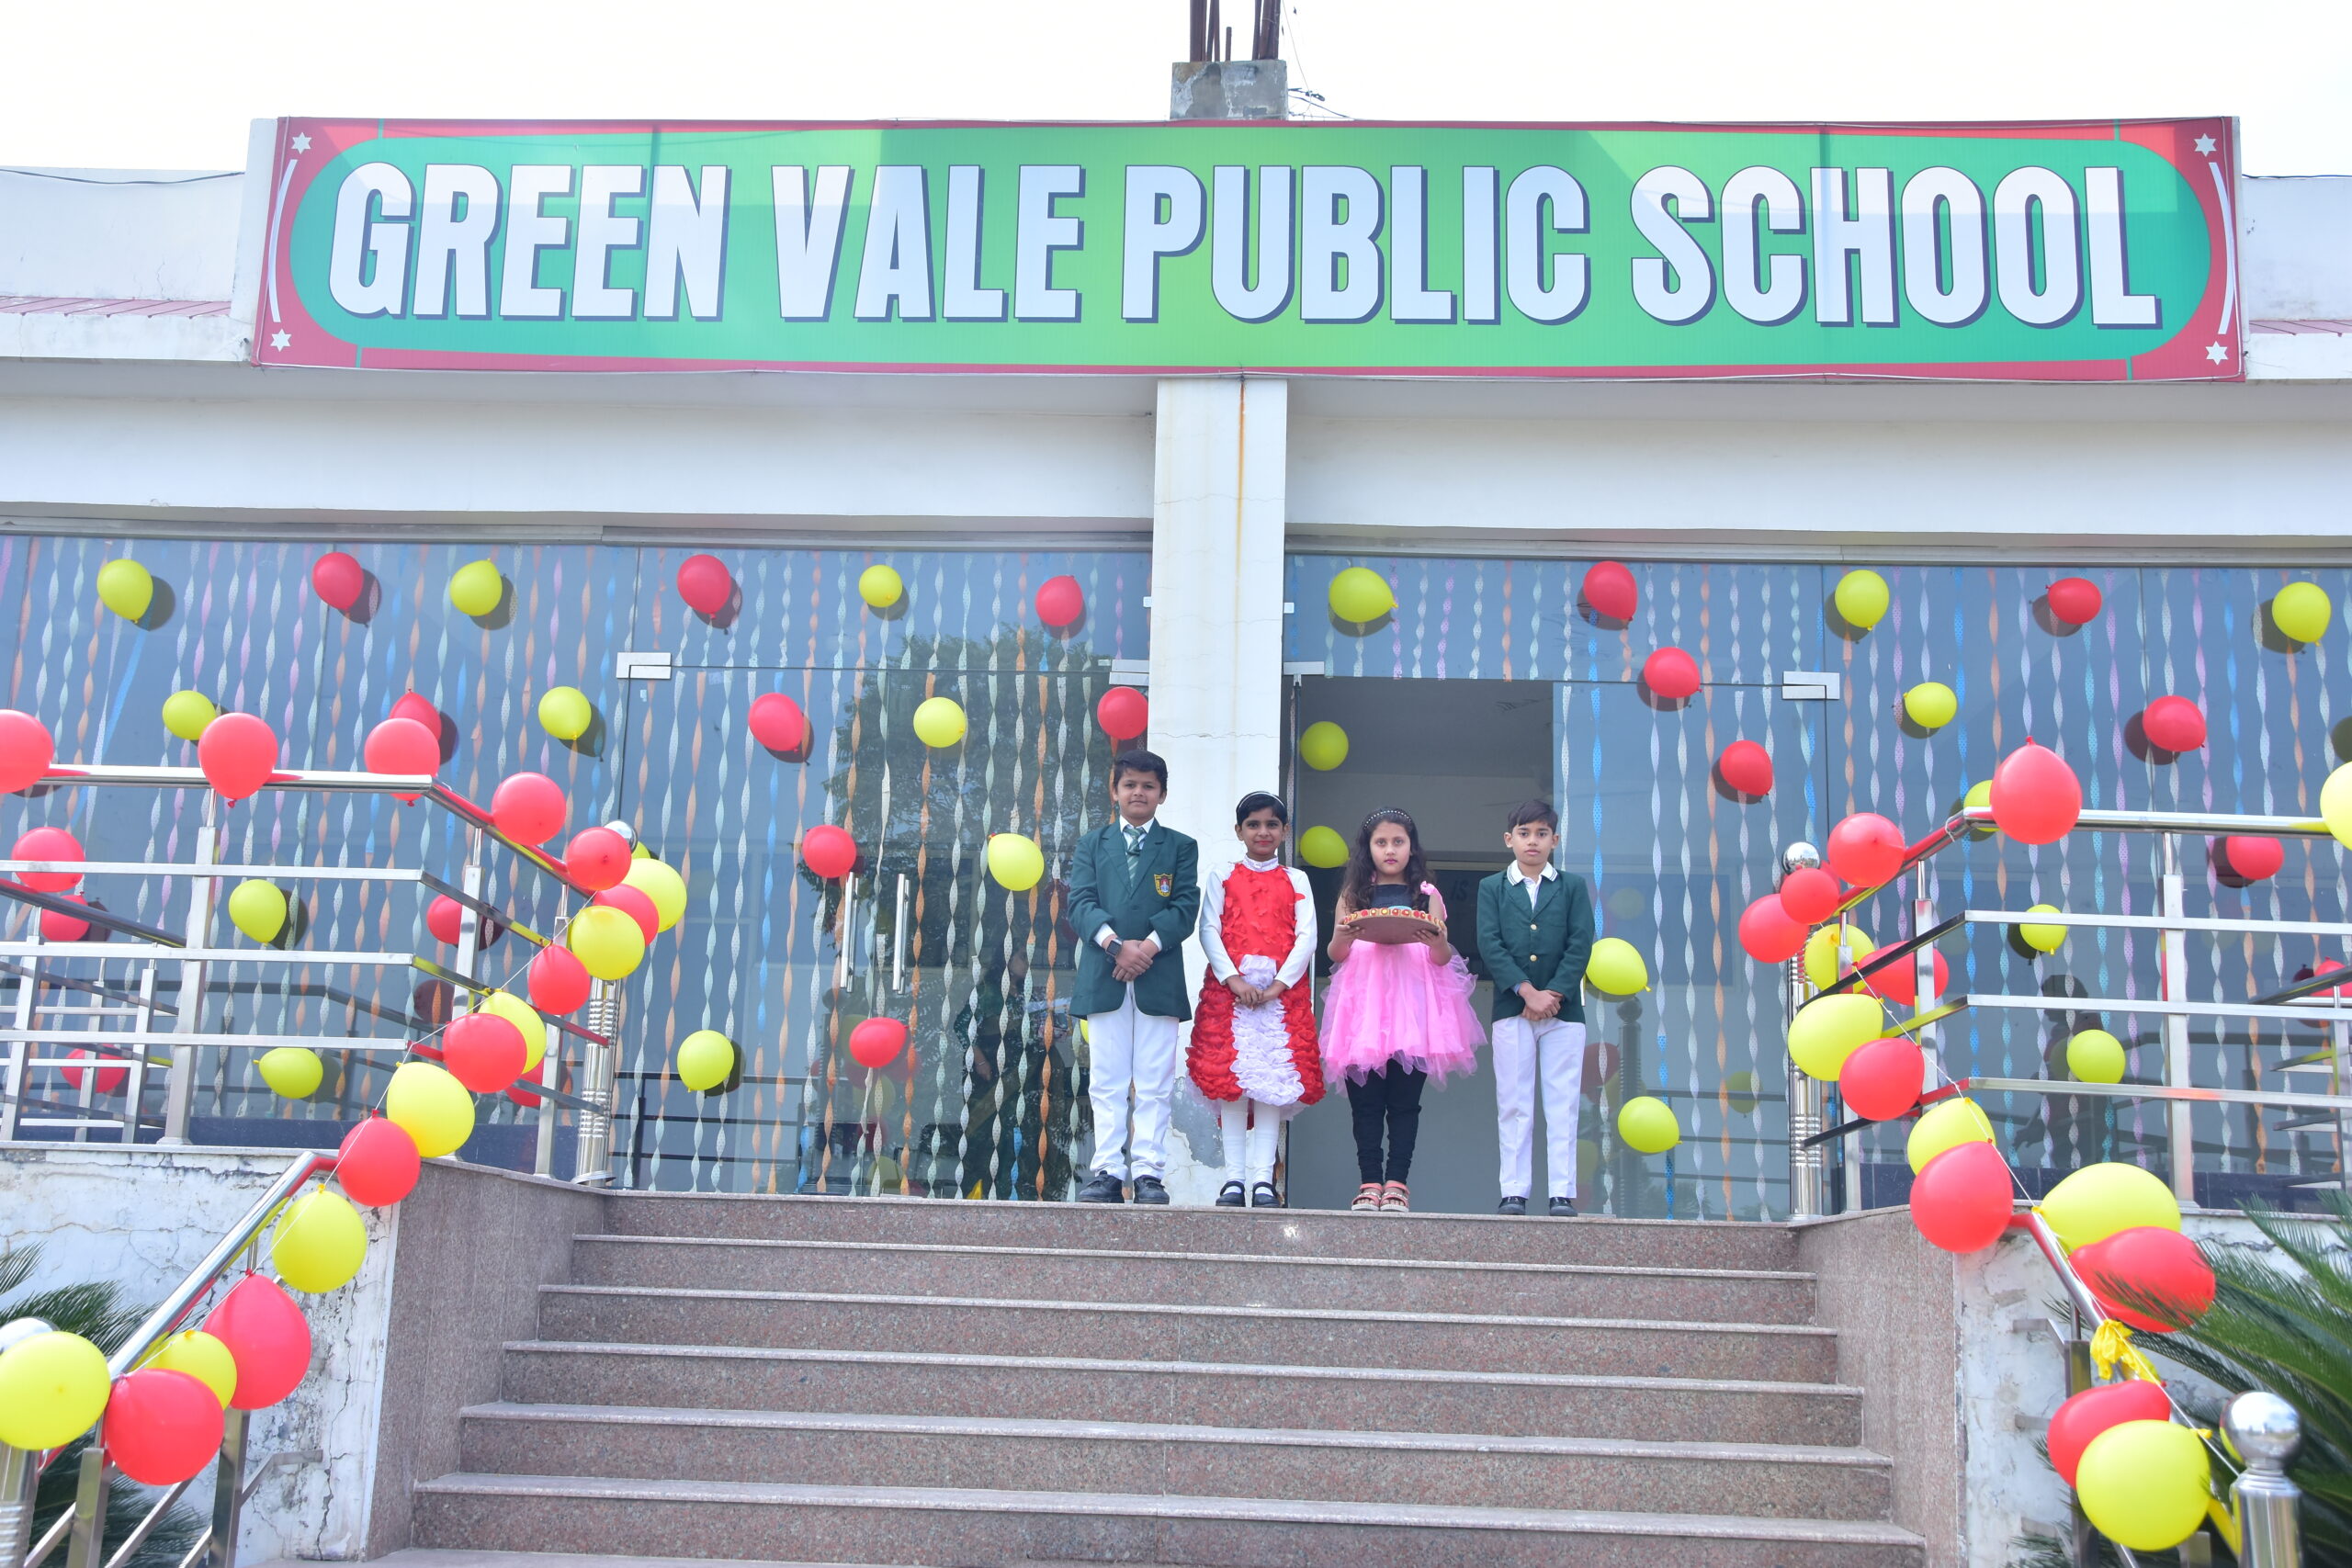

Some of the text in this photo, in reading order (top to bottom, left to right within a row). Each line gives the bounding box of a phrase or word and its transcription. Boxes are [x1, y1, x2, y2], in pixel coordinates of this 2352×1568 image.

[329, 162, 2163, 329] GREEN VALE PUBLIC SCHOOL
